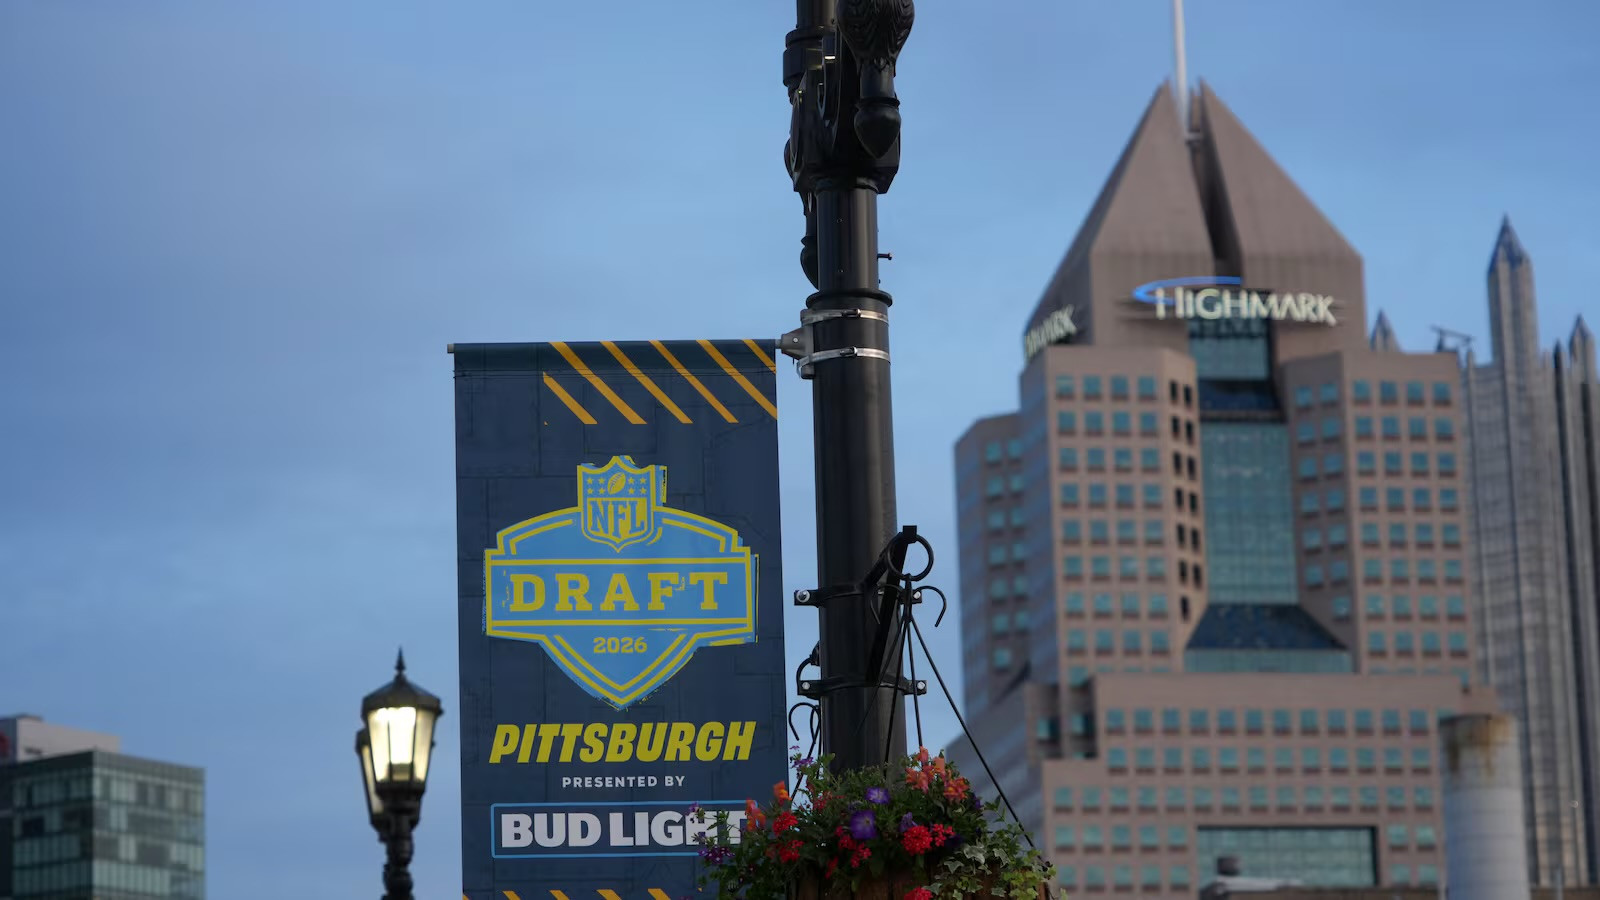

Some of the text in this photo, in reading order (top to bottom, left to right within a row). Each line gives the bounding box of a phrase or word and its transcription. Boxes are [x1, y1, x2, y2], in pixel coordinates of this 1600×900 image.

[1155, 287, 1337, 326] HIGHMARK
[589, 500, 645, 534] NFL
[508, 572, 728, 612] DRAFT
[593, 637, 648, 653] 2026
[488, 721, 757, 763] PITTSBURGH
[562, 775, 686, 788] PRESENTED BY
[501, 812, 602, 848] BUD
